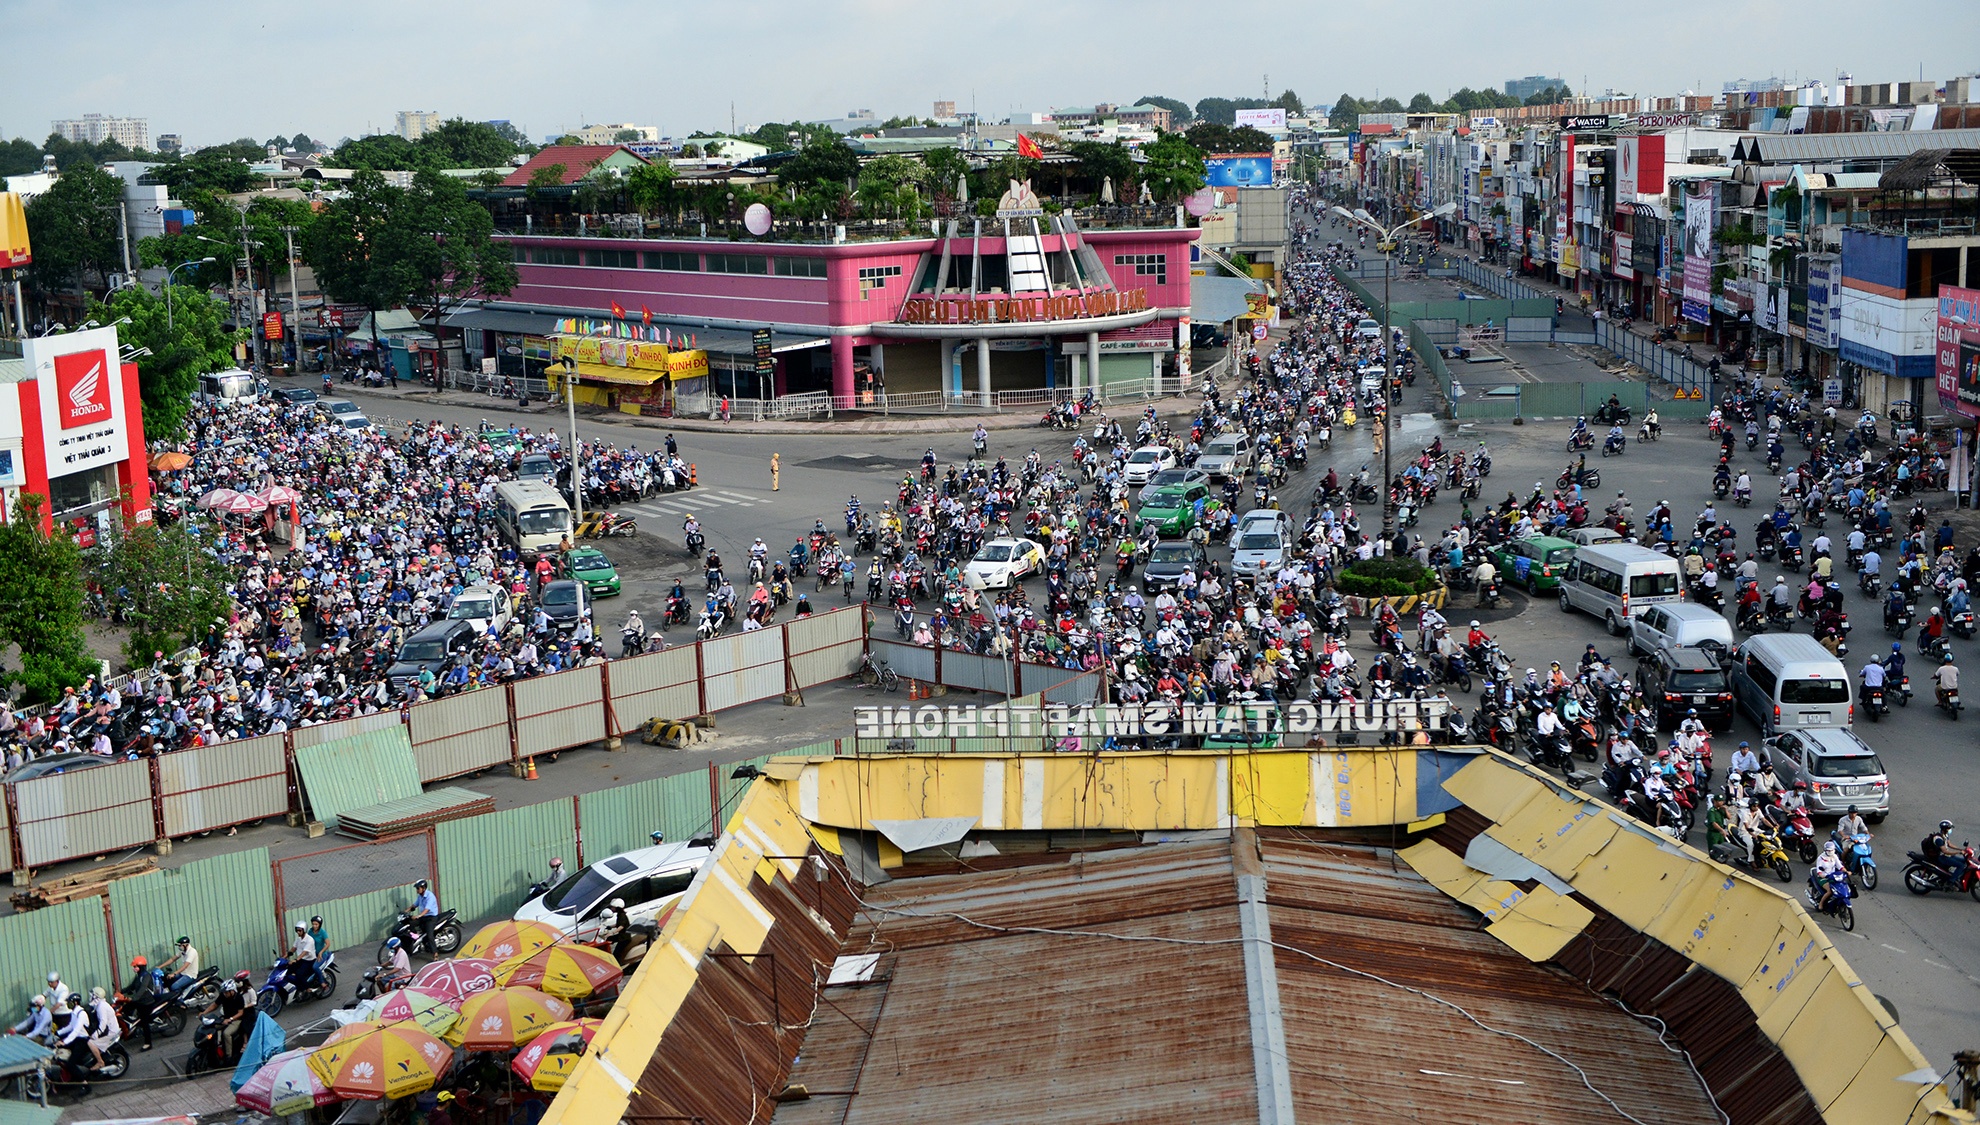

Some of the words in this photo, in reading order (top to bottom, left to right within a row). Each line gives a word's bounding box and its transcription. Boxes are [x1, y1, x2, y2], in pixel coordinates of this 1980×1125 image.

[1638, 116, 1664, 126] BIBO
[1666, 114, 1692, 126] MART
[1938, 322, 1960, 346] GIẢM
[640, 352, 652, 360] KINH
[669, 360, 692, 372] KINH
[693, 356, 708, 368] ĐÔ
[1941, 348, 1956, 368] GIÁ
[1940, 369, 1957, 392] HẾT
[70, 402, 105, 418] HONDA
[64, 452, 76, 464] VIỆT
[77, 448, 90, 460] THÁI
